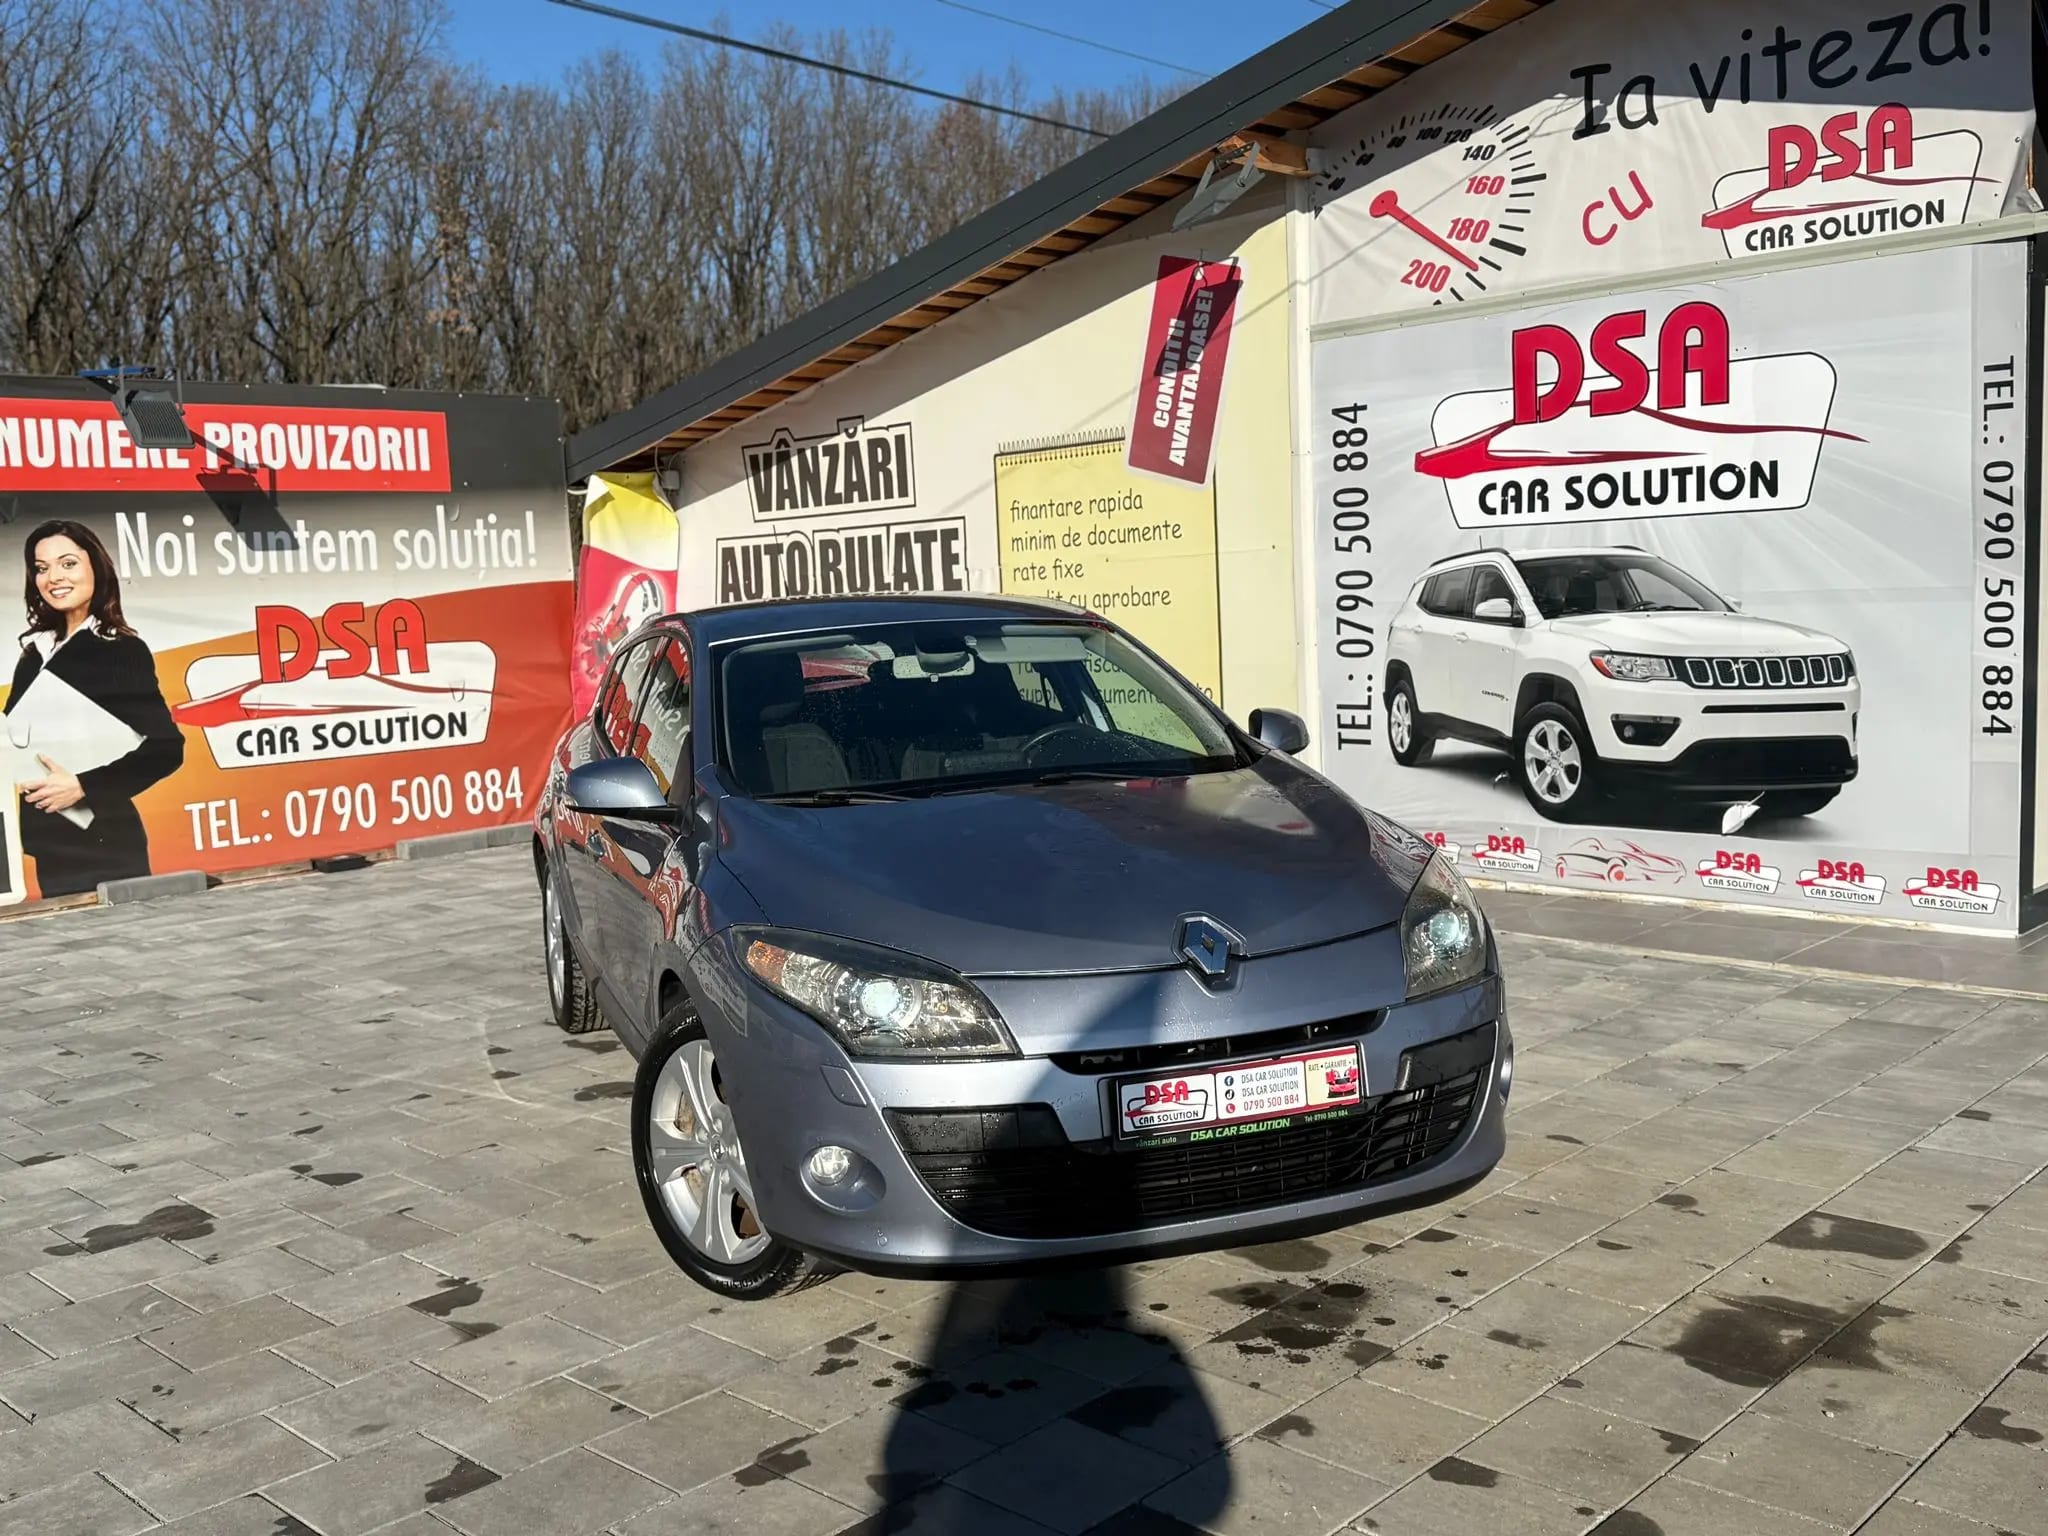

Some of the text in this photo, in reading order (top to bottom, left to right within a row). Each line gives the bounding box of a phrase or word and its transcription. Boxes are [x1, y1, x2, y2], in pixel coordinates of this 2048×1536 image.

[1570, 0, 1991, 141] Ia viteza!
[1416, 126, 1443, 141] 100
[1444, 128, 1474, 145] 120
[1768, 102, 1914, 191] DSA
[1462, 144, 1497, 161] 140
[1465, 175, 1505, 196] 160
[1582, 170, 1653, 246] cu
[1446, 216, 1491, 243] 180
[1744, 198, 1946, 253] CAR SOLUTION
[1400, 258, 1452, 293] 200
[1512, 301, 1730, 425] DSA
[1168, 289, 1214, 467] AVANTAJOASE!
[203, 421, 431, 472] PROVIZORII
[748, 427, 909, 513] VÂNZĂRI
[1477, 460, 1779, 516] CAR SOLUTION
[1010, 488, 1143, 523] finantare rapida
[114, 511, 199, 579] Noi
[213, 519, 379, 577] suntem
[1011, 519, 1183, 552] minim de documente
[1981, 354, 2015, 737] TEL.: 0790 500 884
[720, 527, 963, 604] AUTO RULATE
[1013, 558, 1085, 582] rate fixe
[1331, 402, 1374, 751] TEL.: 0790 500 884
[1092, 585, 1172, 615] aprobare
[255, 598, 430, 684] DSA
[236, 711, 468, 758] CAR SOLUTION
[184, 766, 524, 852] TEL.: 0790 500 884
[1487, 834, 1526, 854] DSA
[1498, 861, 1535, 871] SOLUTION
[1716, 850, 1761, 873] DSA
[1817, 859, 1865, 883] DSA
[1708, 878, 1771, 892] CAR SOLUTION
[1926, 867, 1978, 891] DSA
[1810, 888, 1875, 902] CAR SOLUTION
[1918, 897, 1988, 911] CAR SOLUTION
[1241, 1066, 1298, 1084] DSA CAR SOLUTION
[1242, 1080, 1299, 1098] DSA CAR SOLUTION
[1144, 1080, 1189, 1106] DSA
[1243, 1099, 1265, 1111] 0790
[1267, 1096, 1282, 1108] 500
[1138, 1110, 1199, 1125] CAR SOLUTION
[1190, 1117, 1291, 1141] DSA CAR SOLUTION
